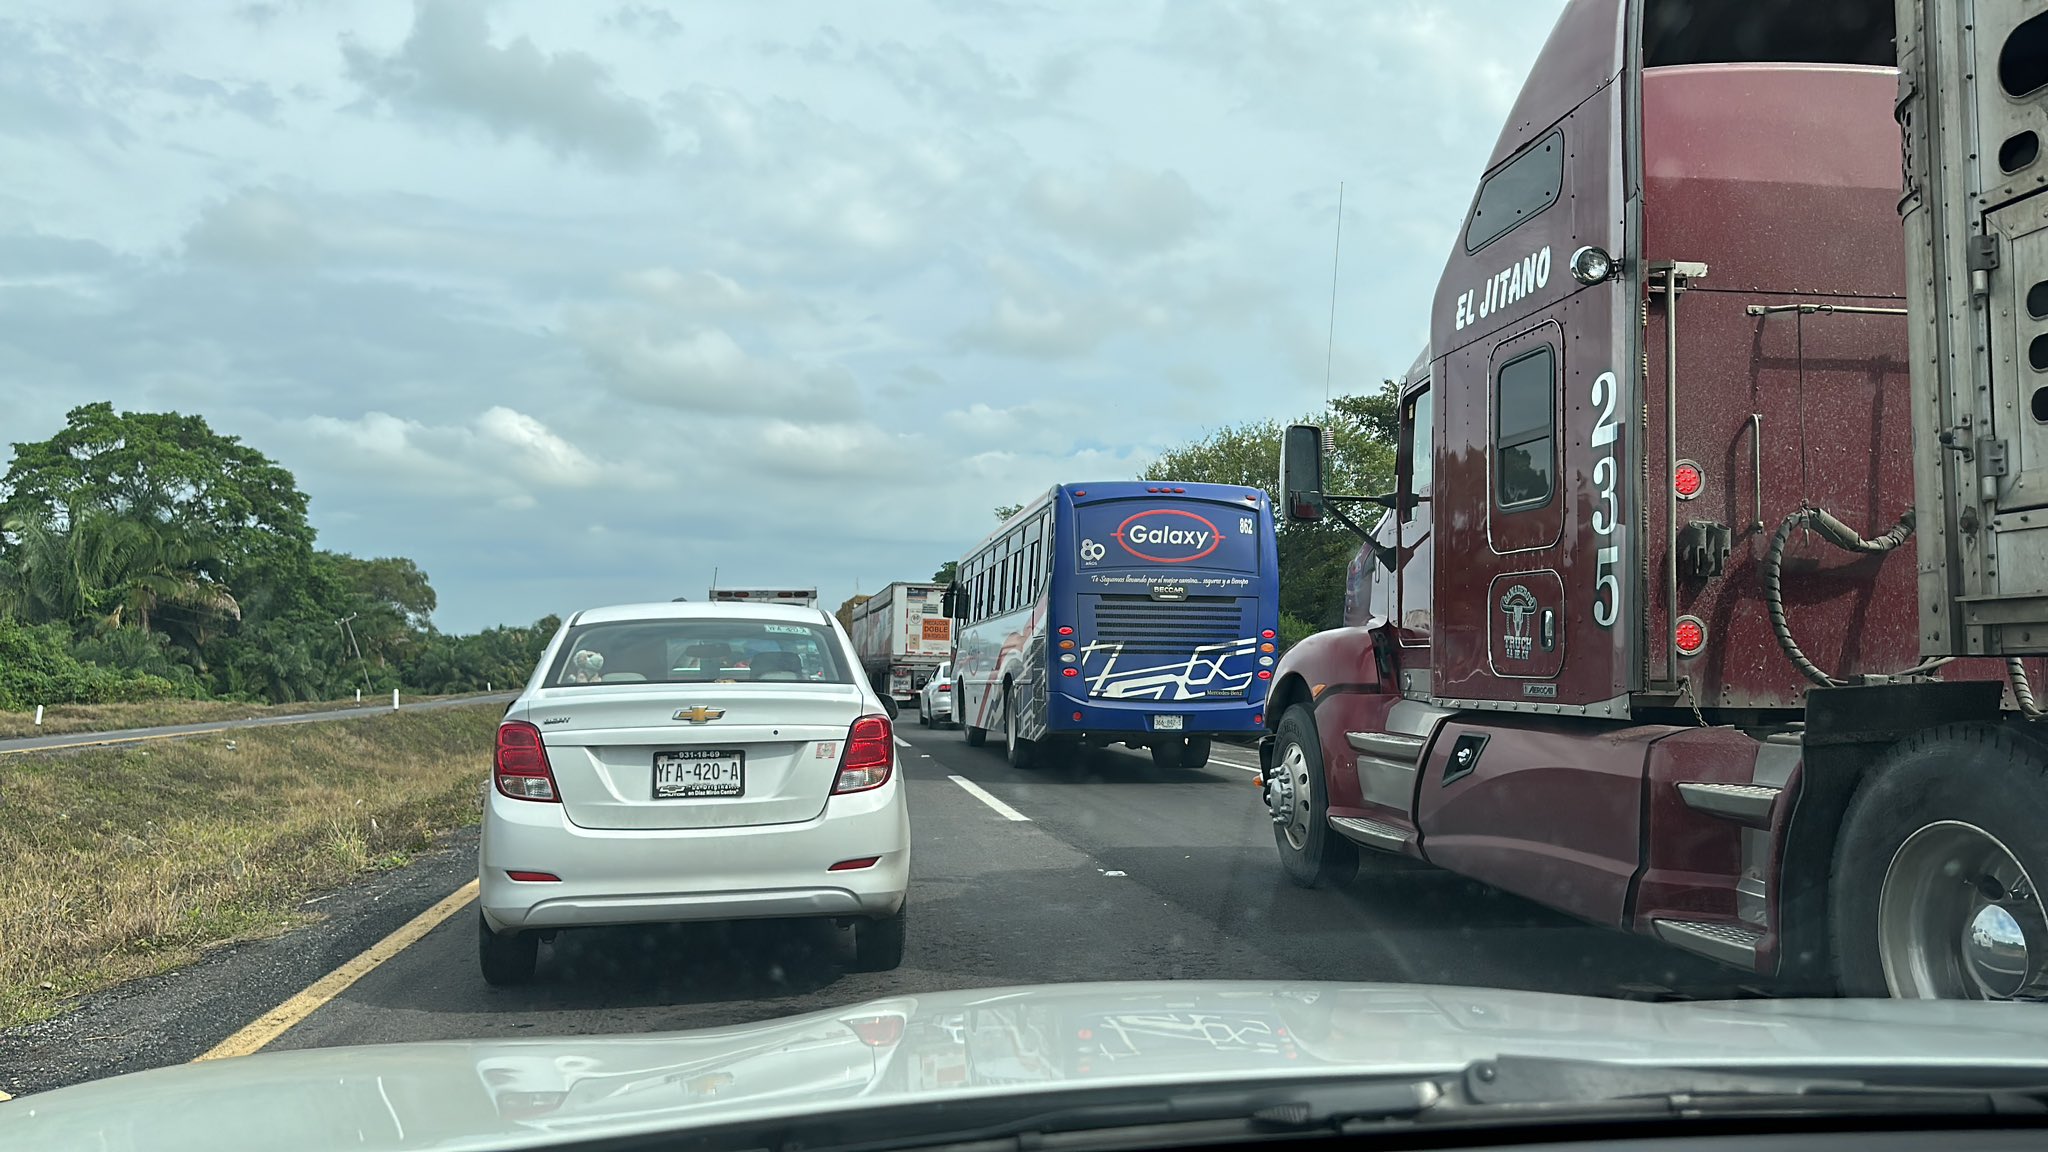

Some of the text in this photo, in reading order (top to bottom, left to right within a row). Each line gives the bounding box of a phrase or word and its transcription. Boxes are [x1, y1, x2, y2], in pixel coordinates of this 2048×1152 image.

[1456, 246, 1551, 331] EL JITANO
[1591, 371, 1620, 627] 235
[1129, 525, 1209, 549] Galaxy
[1240, 517, 1253, 535] 862
[1147, 577, 1157, 586] por
[657, 762, 739, 782] YFA-420-A
